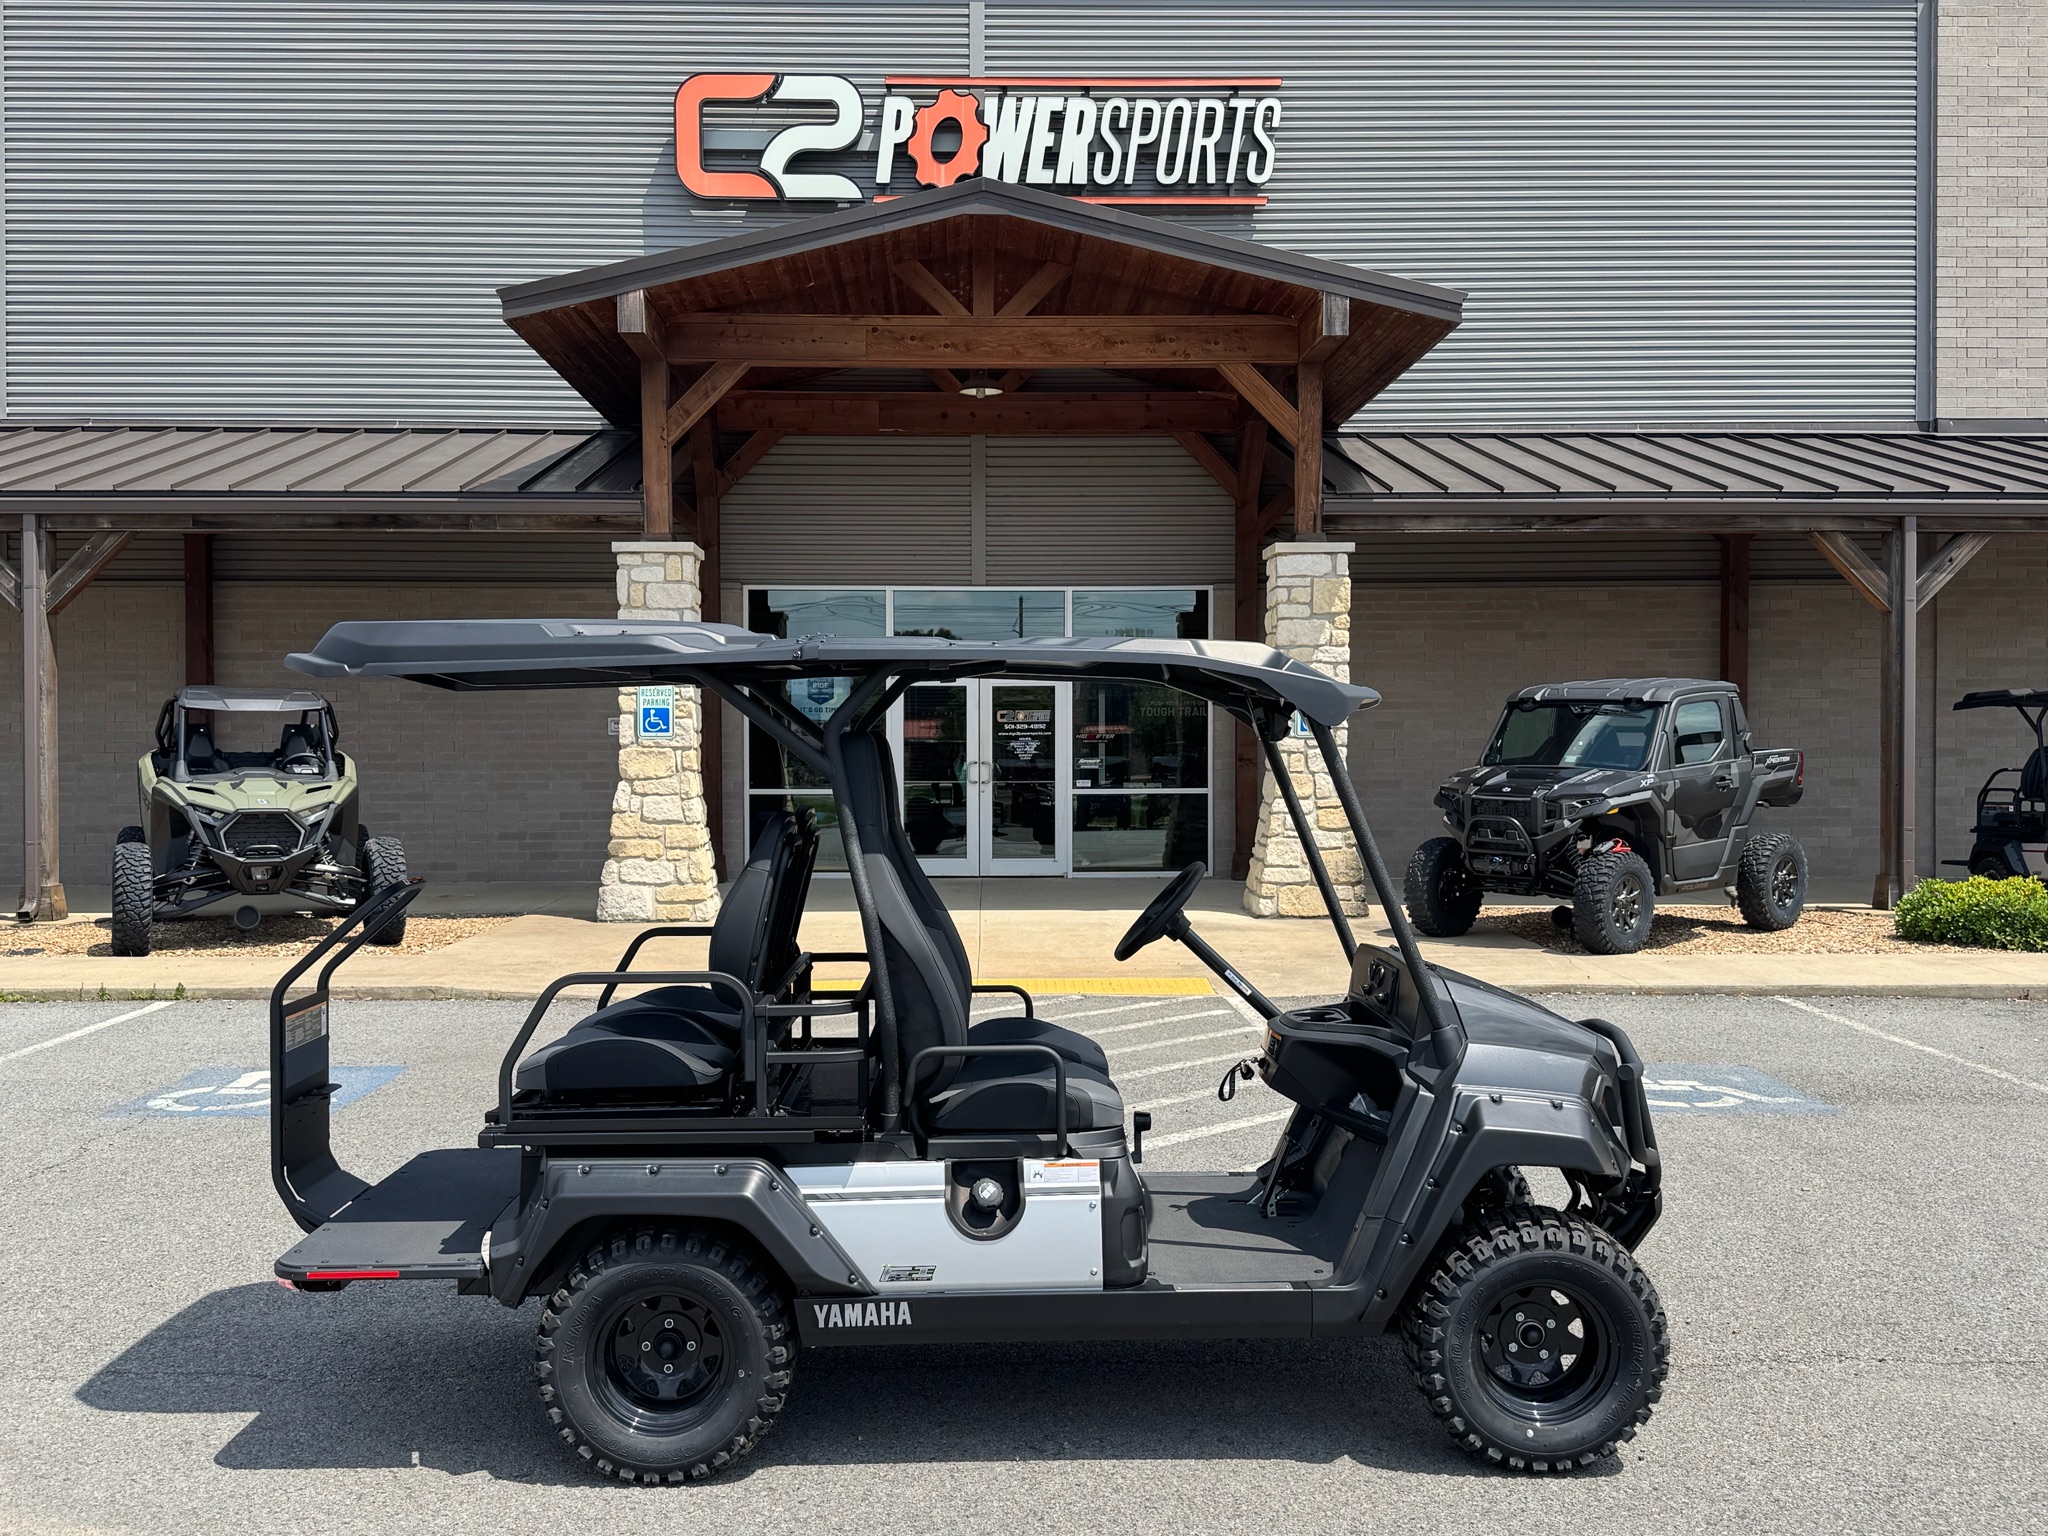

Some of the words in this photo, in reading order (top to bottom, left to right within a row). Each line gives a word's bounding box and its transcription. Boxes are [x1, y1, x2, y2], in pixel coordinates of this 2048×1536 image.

[674, 72, 864, 200] C2
[876, 87, 1283, 190] POWERSPORTS
[640, 688, 672, 697] RESERVED
[642, 698, 671, 707] PARKING
[1139, 707, 1175, 717] TOUGH
[1178, 707, 1207, 717] TRAIL
[1640, 778, 1654, 787] XP
[563, 1295, 604, 1364] KENDA
[618, 1266, 690, 1287] TERRA
[699, 1276, 744, 1319] TRAC
[813, 1301, 913, 1329] YAMAHA
[1621, 1306, 1645, 1376] TERRA
